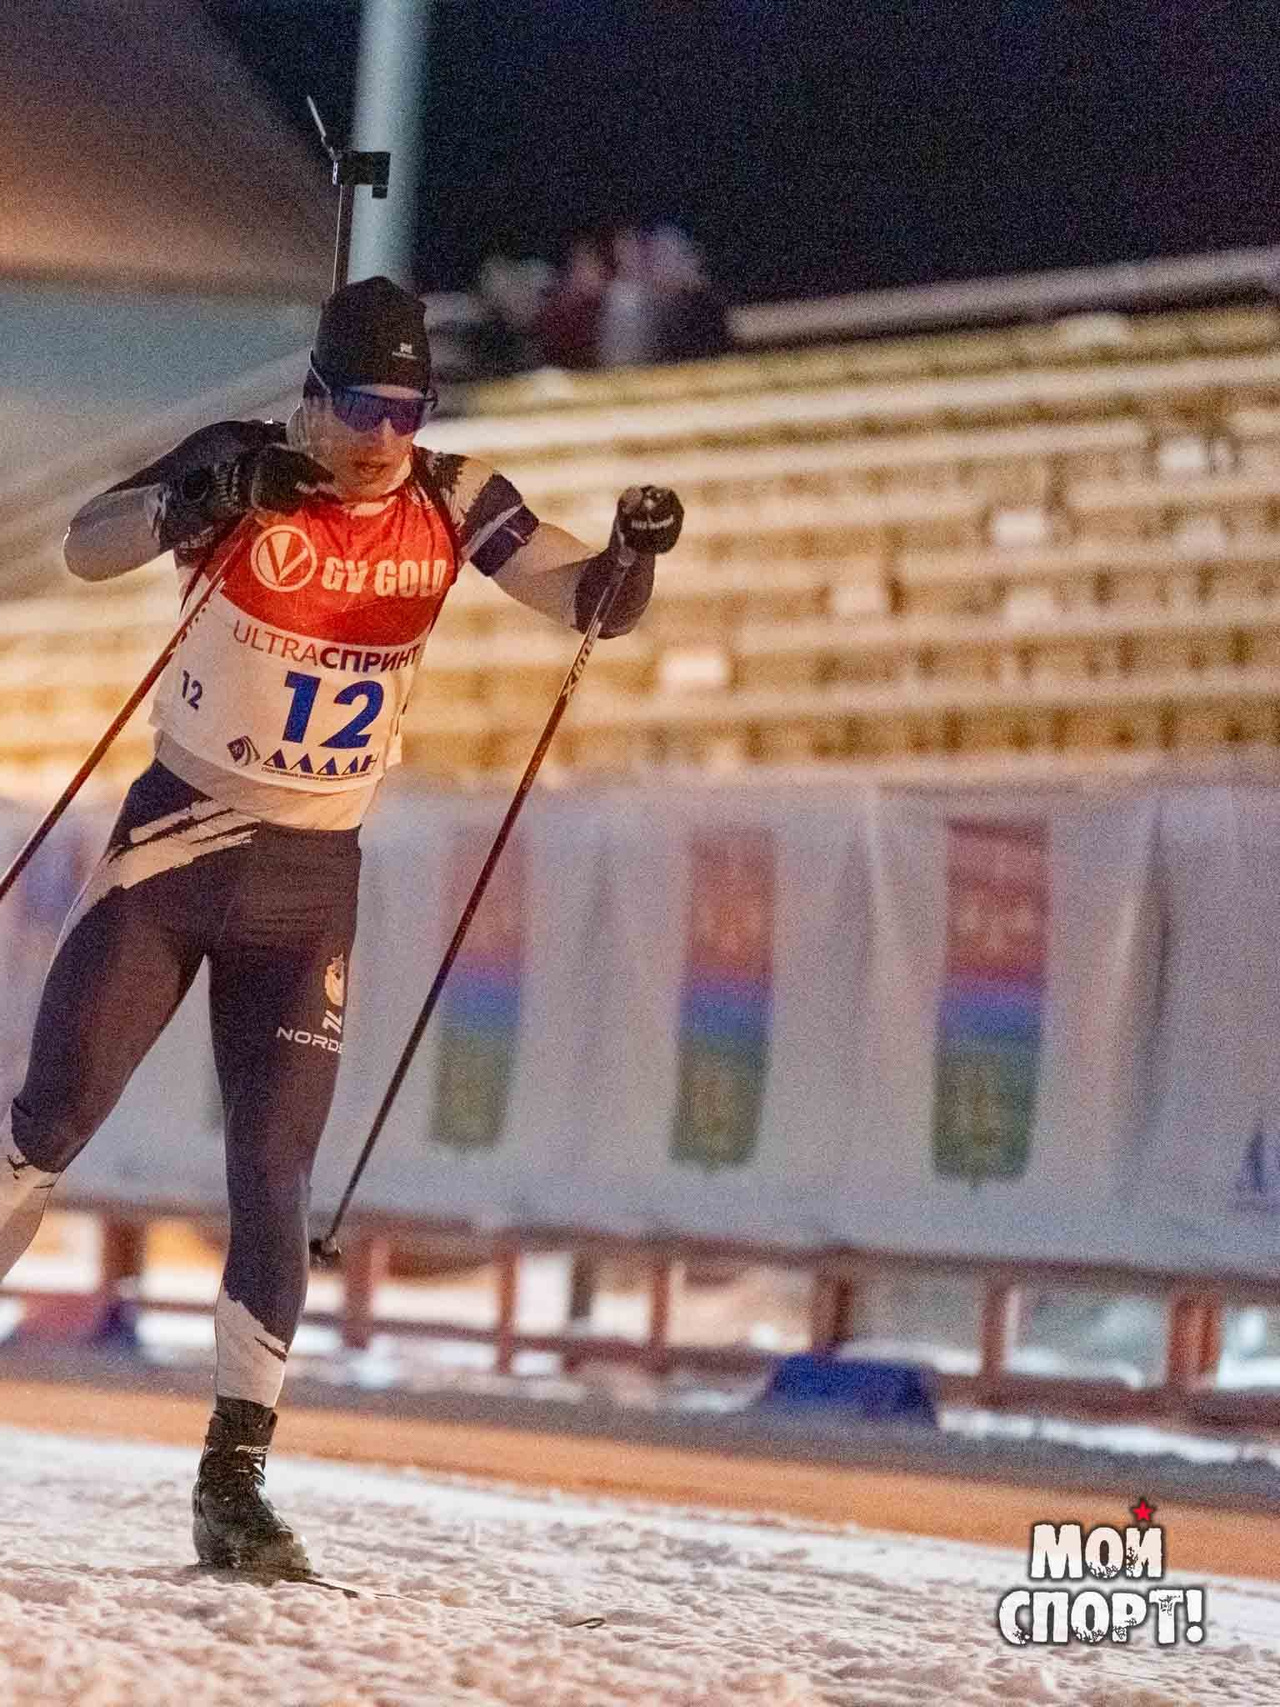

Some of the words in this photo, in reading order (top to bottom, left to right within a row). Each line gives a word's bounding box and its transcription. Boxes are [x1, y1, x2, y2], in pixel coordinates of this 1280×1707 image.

[321, 556, 369, 594] GV
[374, 559, 447, 598] GOLD
[182, 669, 203, 711] 12
[281, 670, 385, 749] 12
